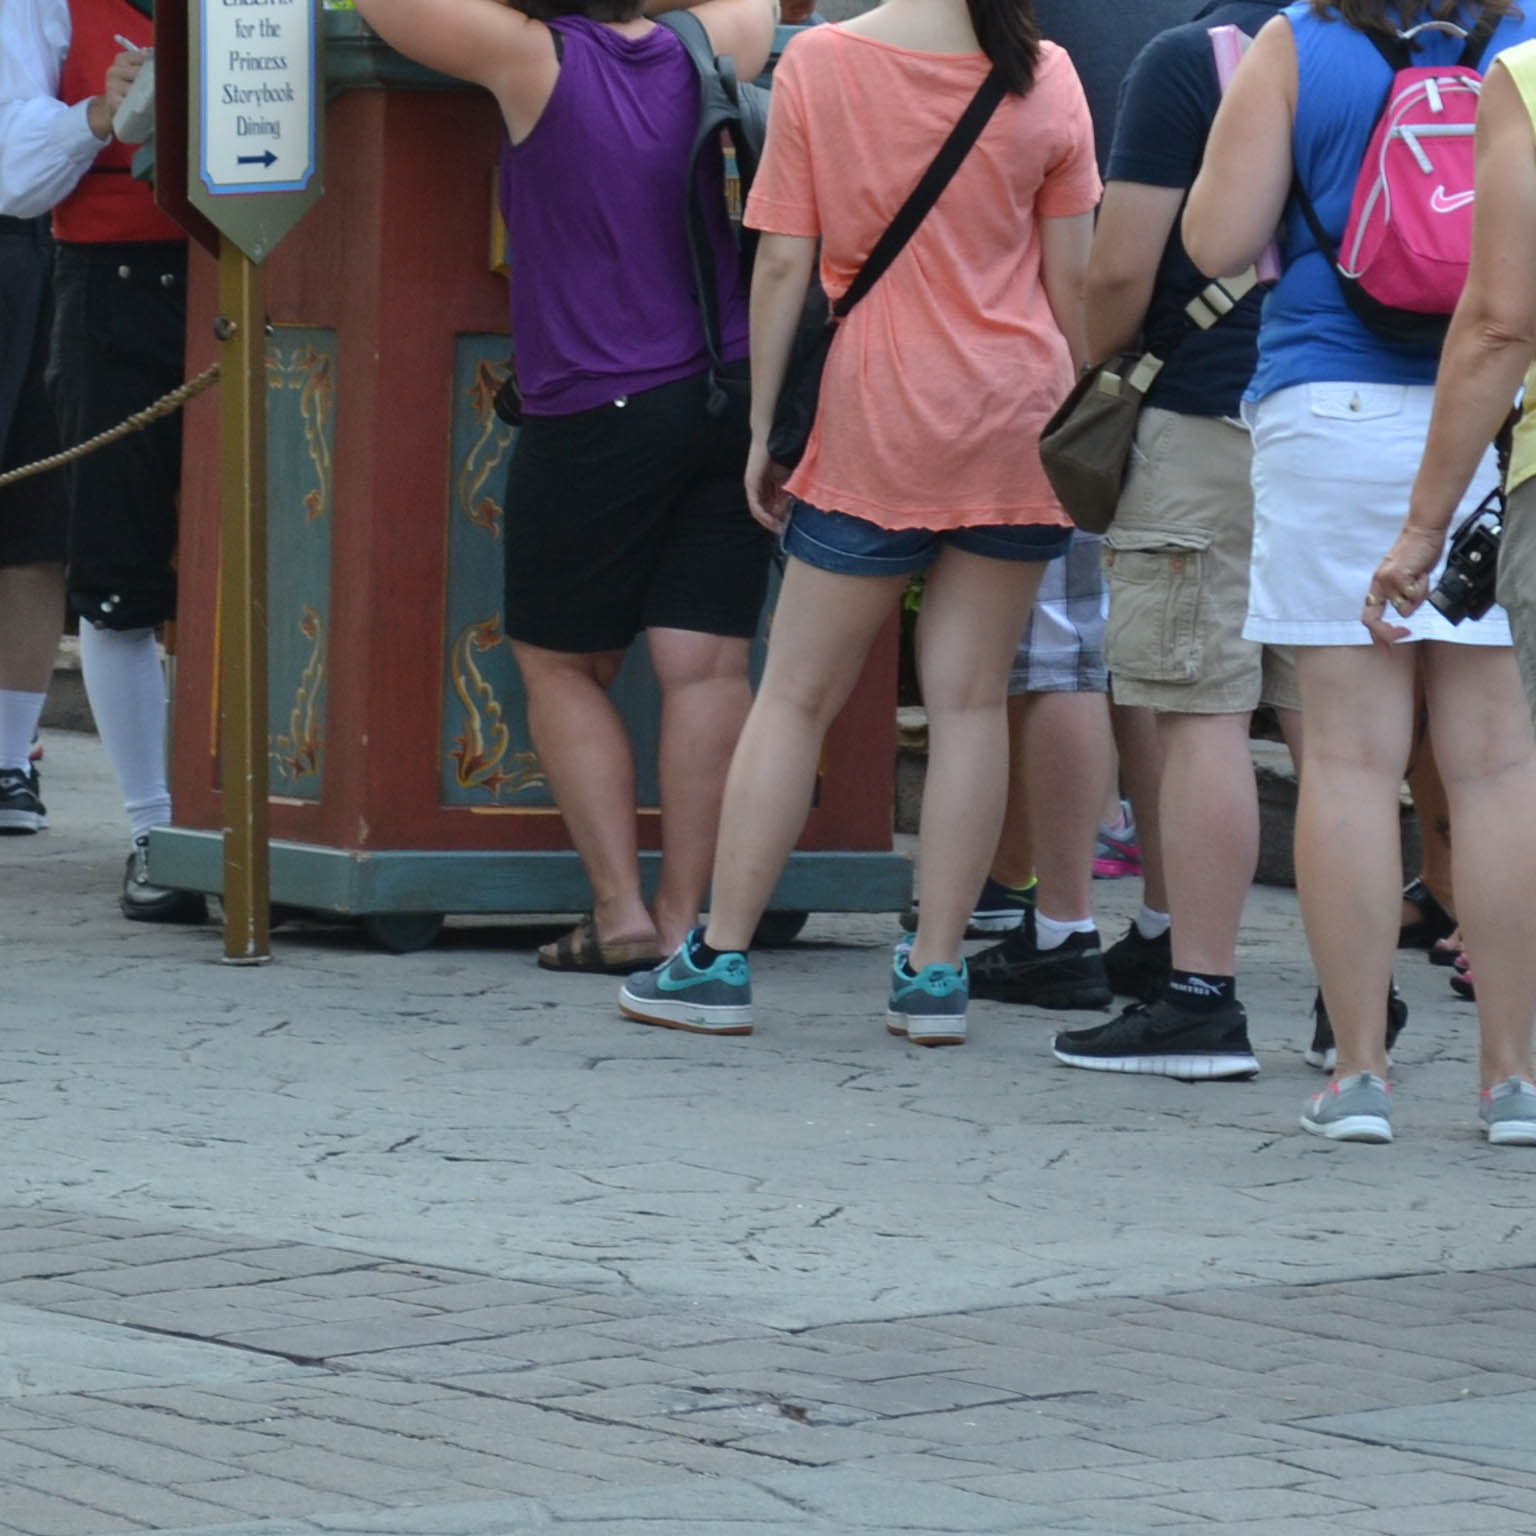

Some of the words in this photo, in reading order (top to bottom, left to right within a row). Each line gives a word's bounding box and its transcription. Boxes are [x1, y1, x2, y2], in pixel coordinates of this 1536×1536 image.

[235, 18, 255, 39] for
[260, 17, 281, 38] the
[229, 50, 288, 72] Princess
[222, 82, 295, 108] Storybook
[237, 115, 281, 140] Dining
